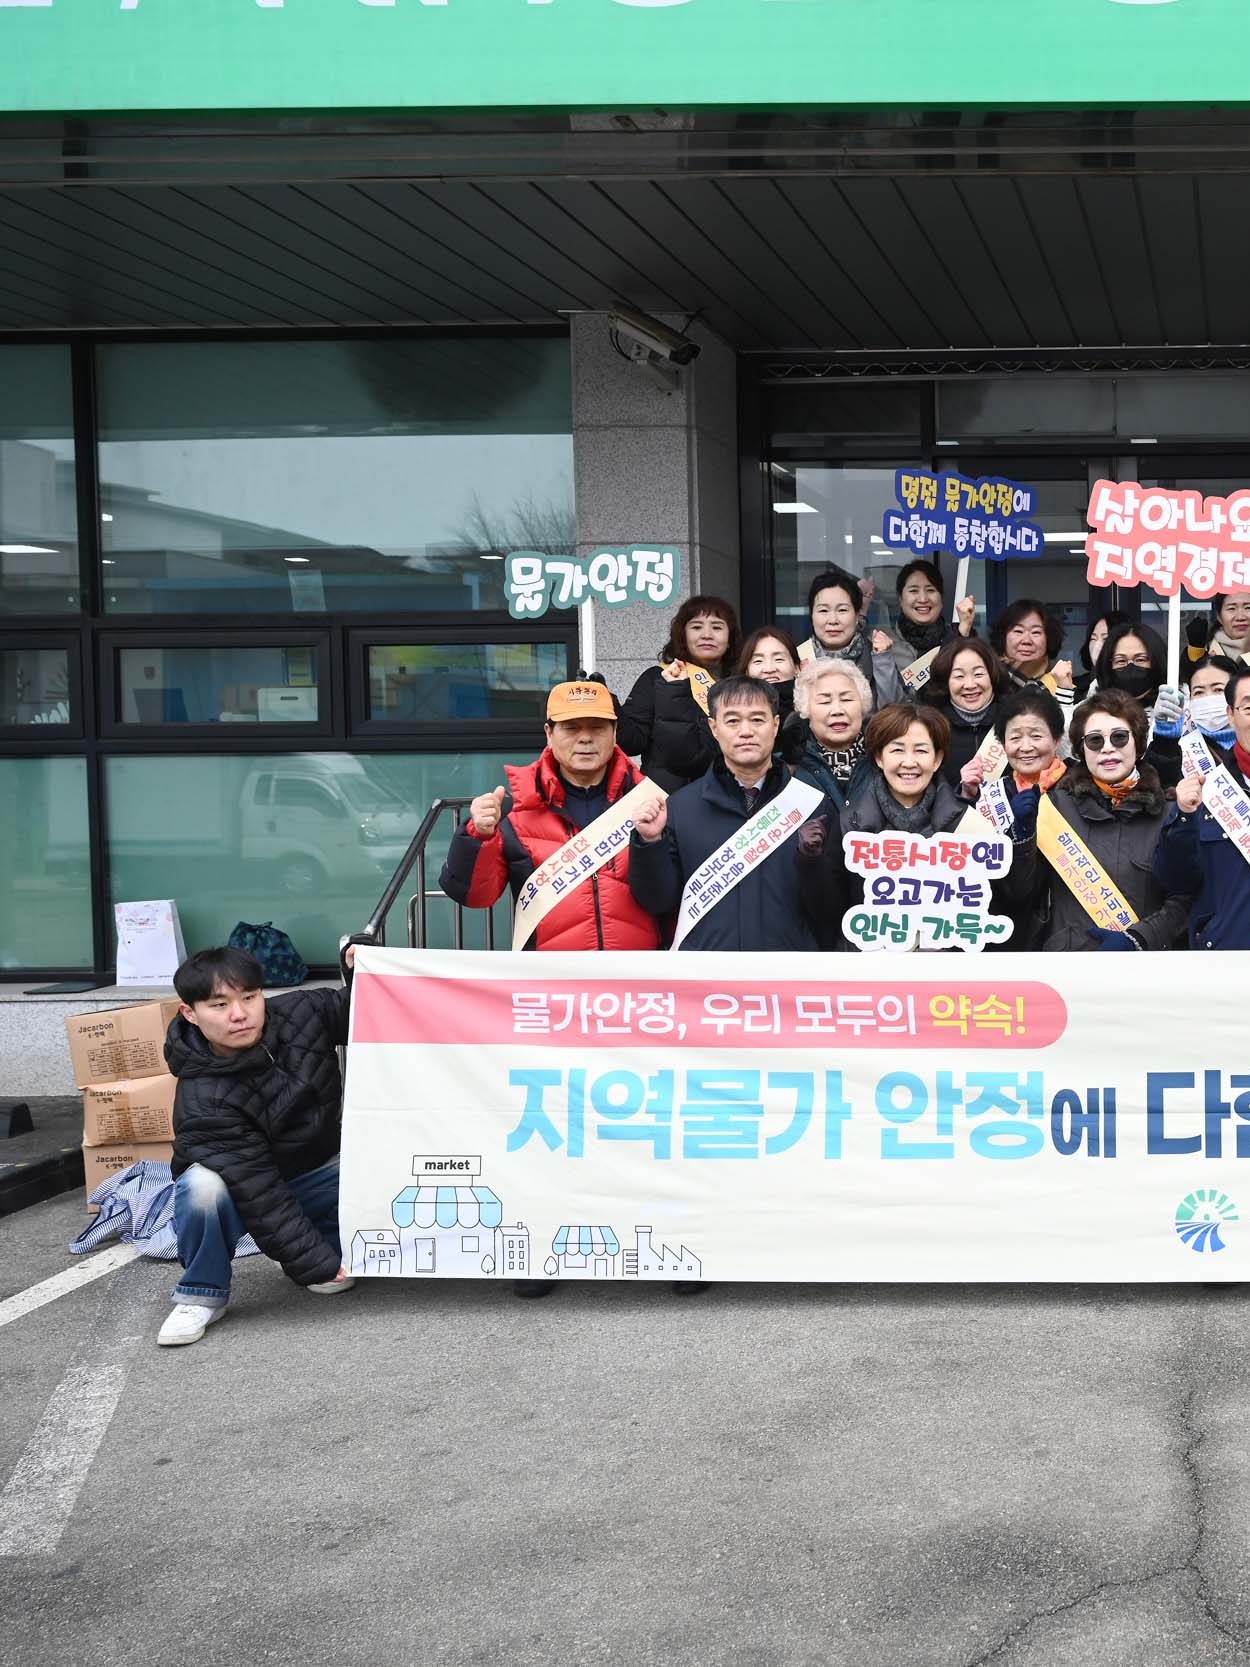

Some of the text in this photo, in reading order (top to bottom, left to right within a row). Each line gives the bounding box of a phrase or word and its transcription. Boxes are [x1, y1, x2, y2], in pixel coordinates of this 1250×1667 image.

[901, 475, 1030, 517] 명절 물가안정에
[889, 514, 1039, 554] 다함께 동참합시다
[510, 550, 675, 613] 물가안정
[1214, 774, 1238, 800] 지역
[1208, 794, 1243, 833] 다함께
[520, 836, 591, 911] 전통시장에서
[683, 805, 783, 902] 전통시장 장보기로!
[687, 808, 804, 920] 즐거운 명절 음식준비는
[850, 839, 1004, 870] 전통시장엔
[552, 855, 595, 895] 먹거리
[872, 876, 983, 907] 오고가는
[1055, 853, 1098, 905] 물가안정
[1057, 832, 1132, 926] 합리적인 소비활
[850, 913, 1005, 944] 인심 가득~
[78, 1022, 114, 1034] Jacarbon
[510, 991, 1025, 1039] 물가안정, 우리 모두의 약속!
[506, 1066, 855, 1160] 지역물가
[872, 1070, 1117, 1160] 안정에
[95, 1155, 133, 1164] Jacarbon
[424, 1159, 470, 1171] market
